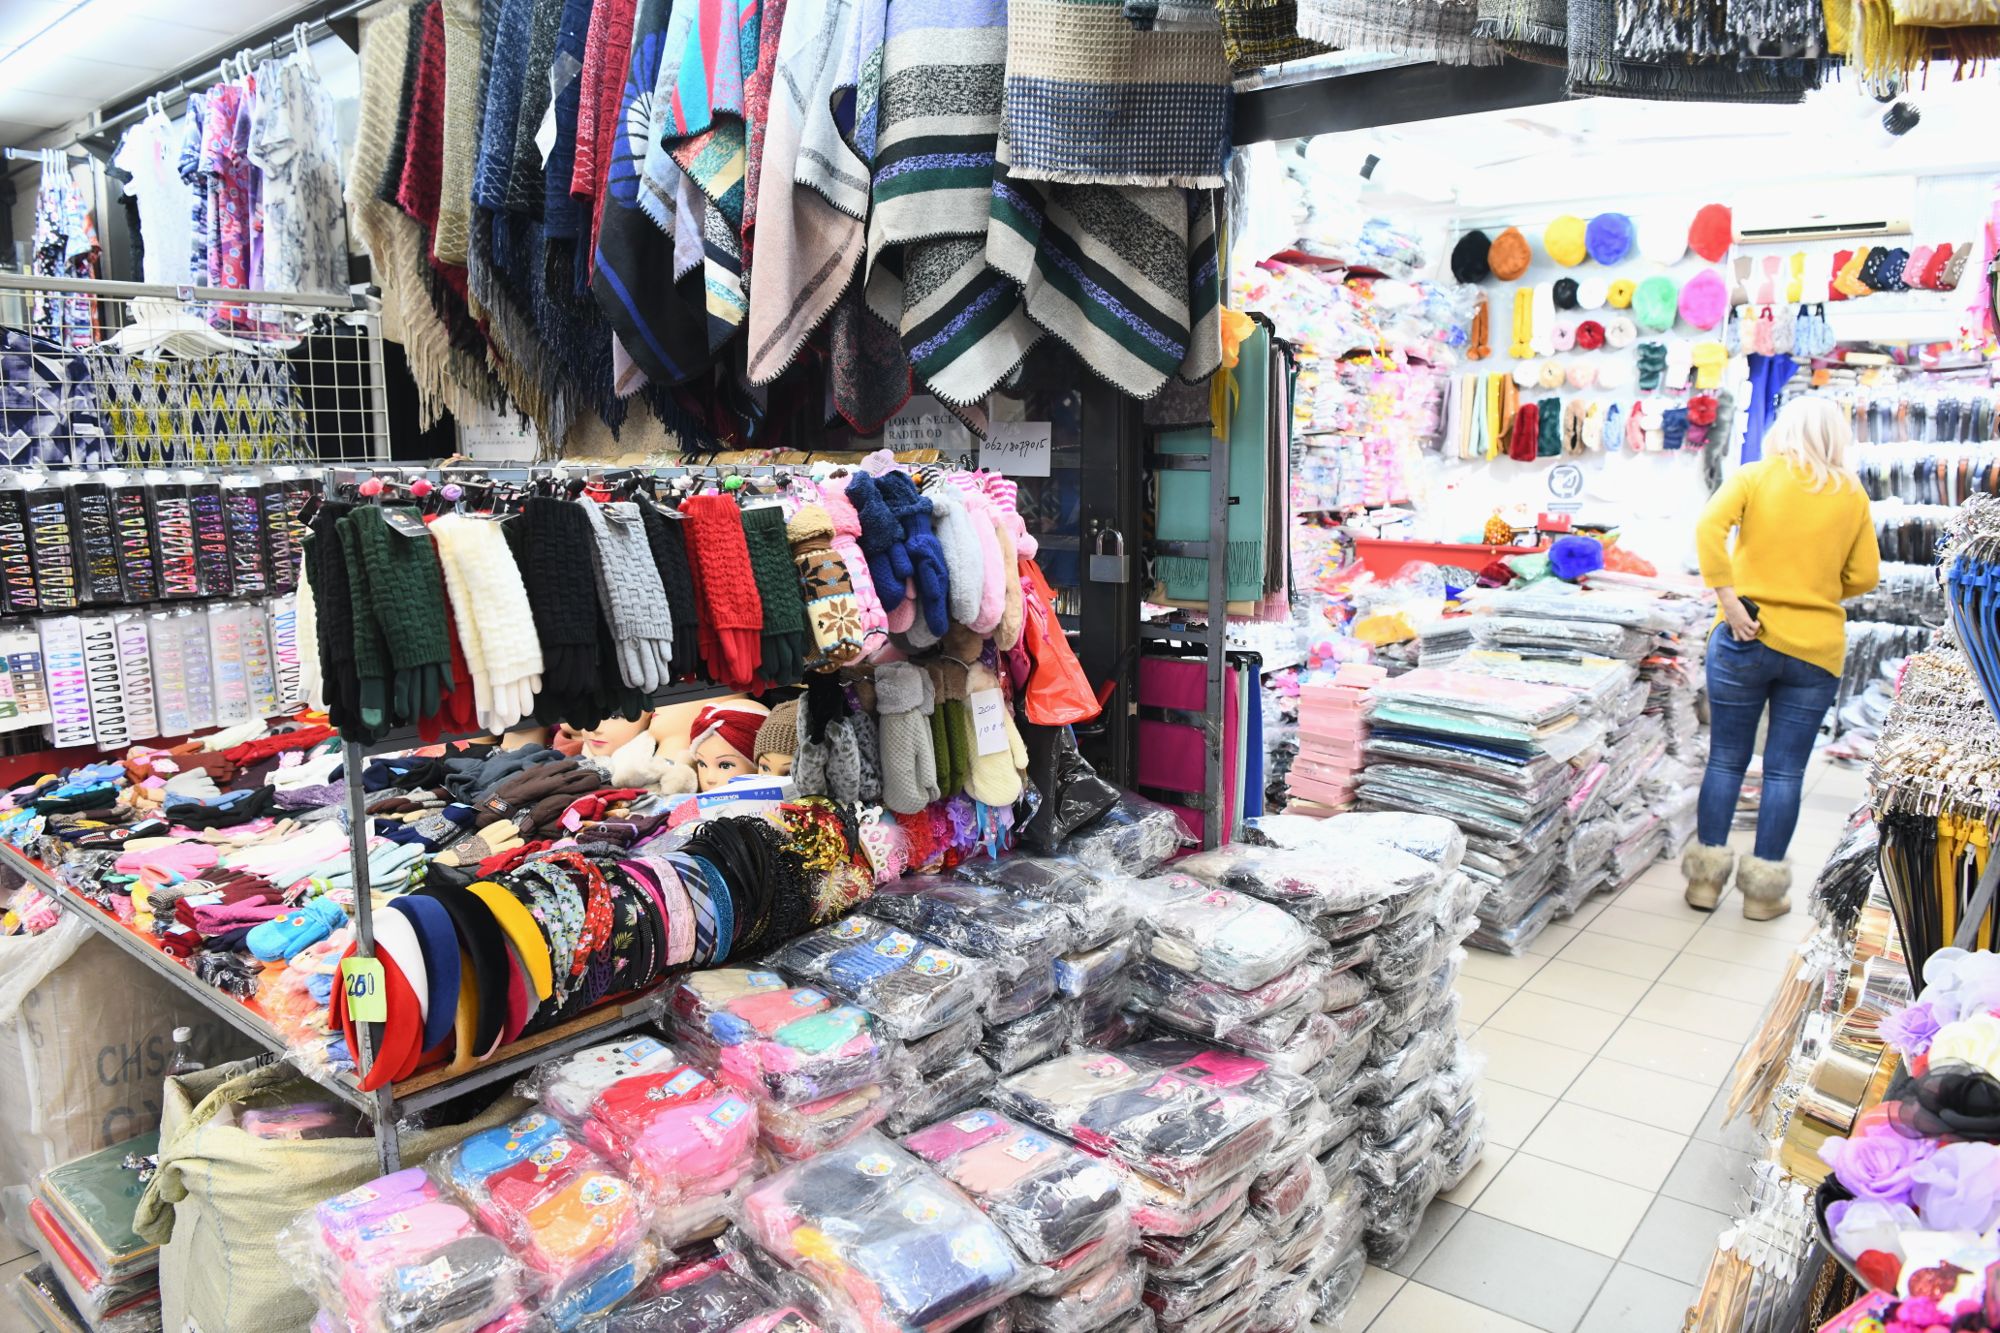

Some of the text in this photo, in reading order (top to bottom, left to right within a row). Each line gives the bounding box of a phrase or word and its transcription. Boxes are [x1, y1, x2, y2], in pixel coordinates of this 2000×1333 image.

[889, 416, 924, 427] LOKAL
[889, 429, 942, 440] RADITI OD
